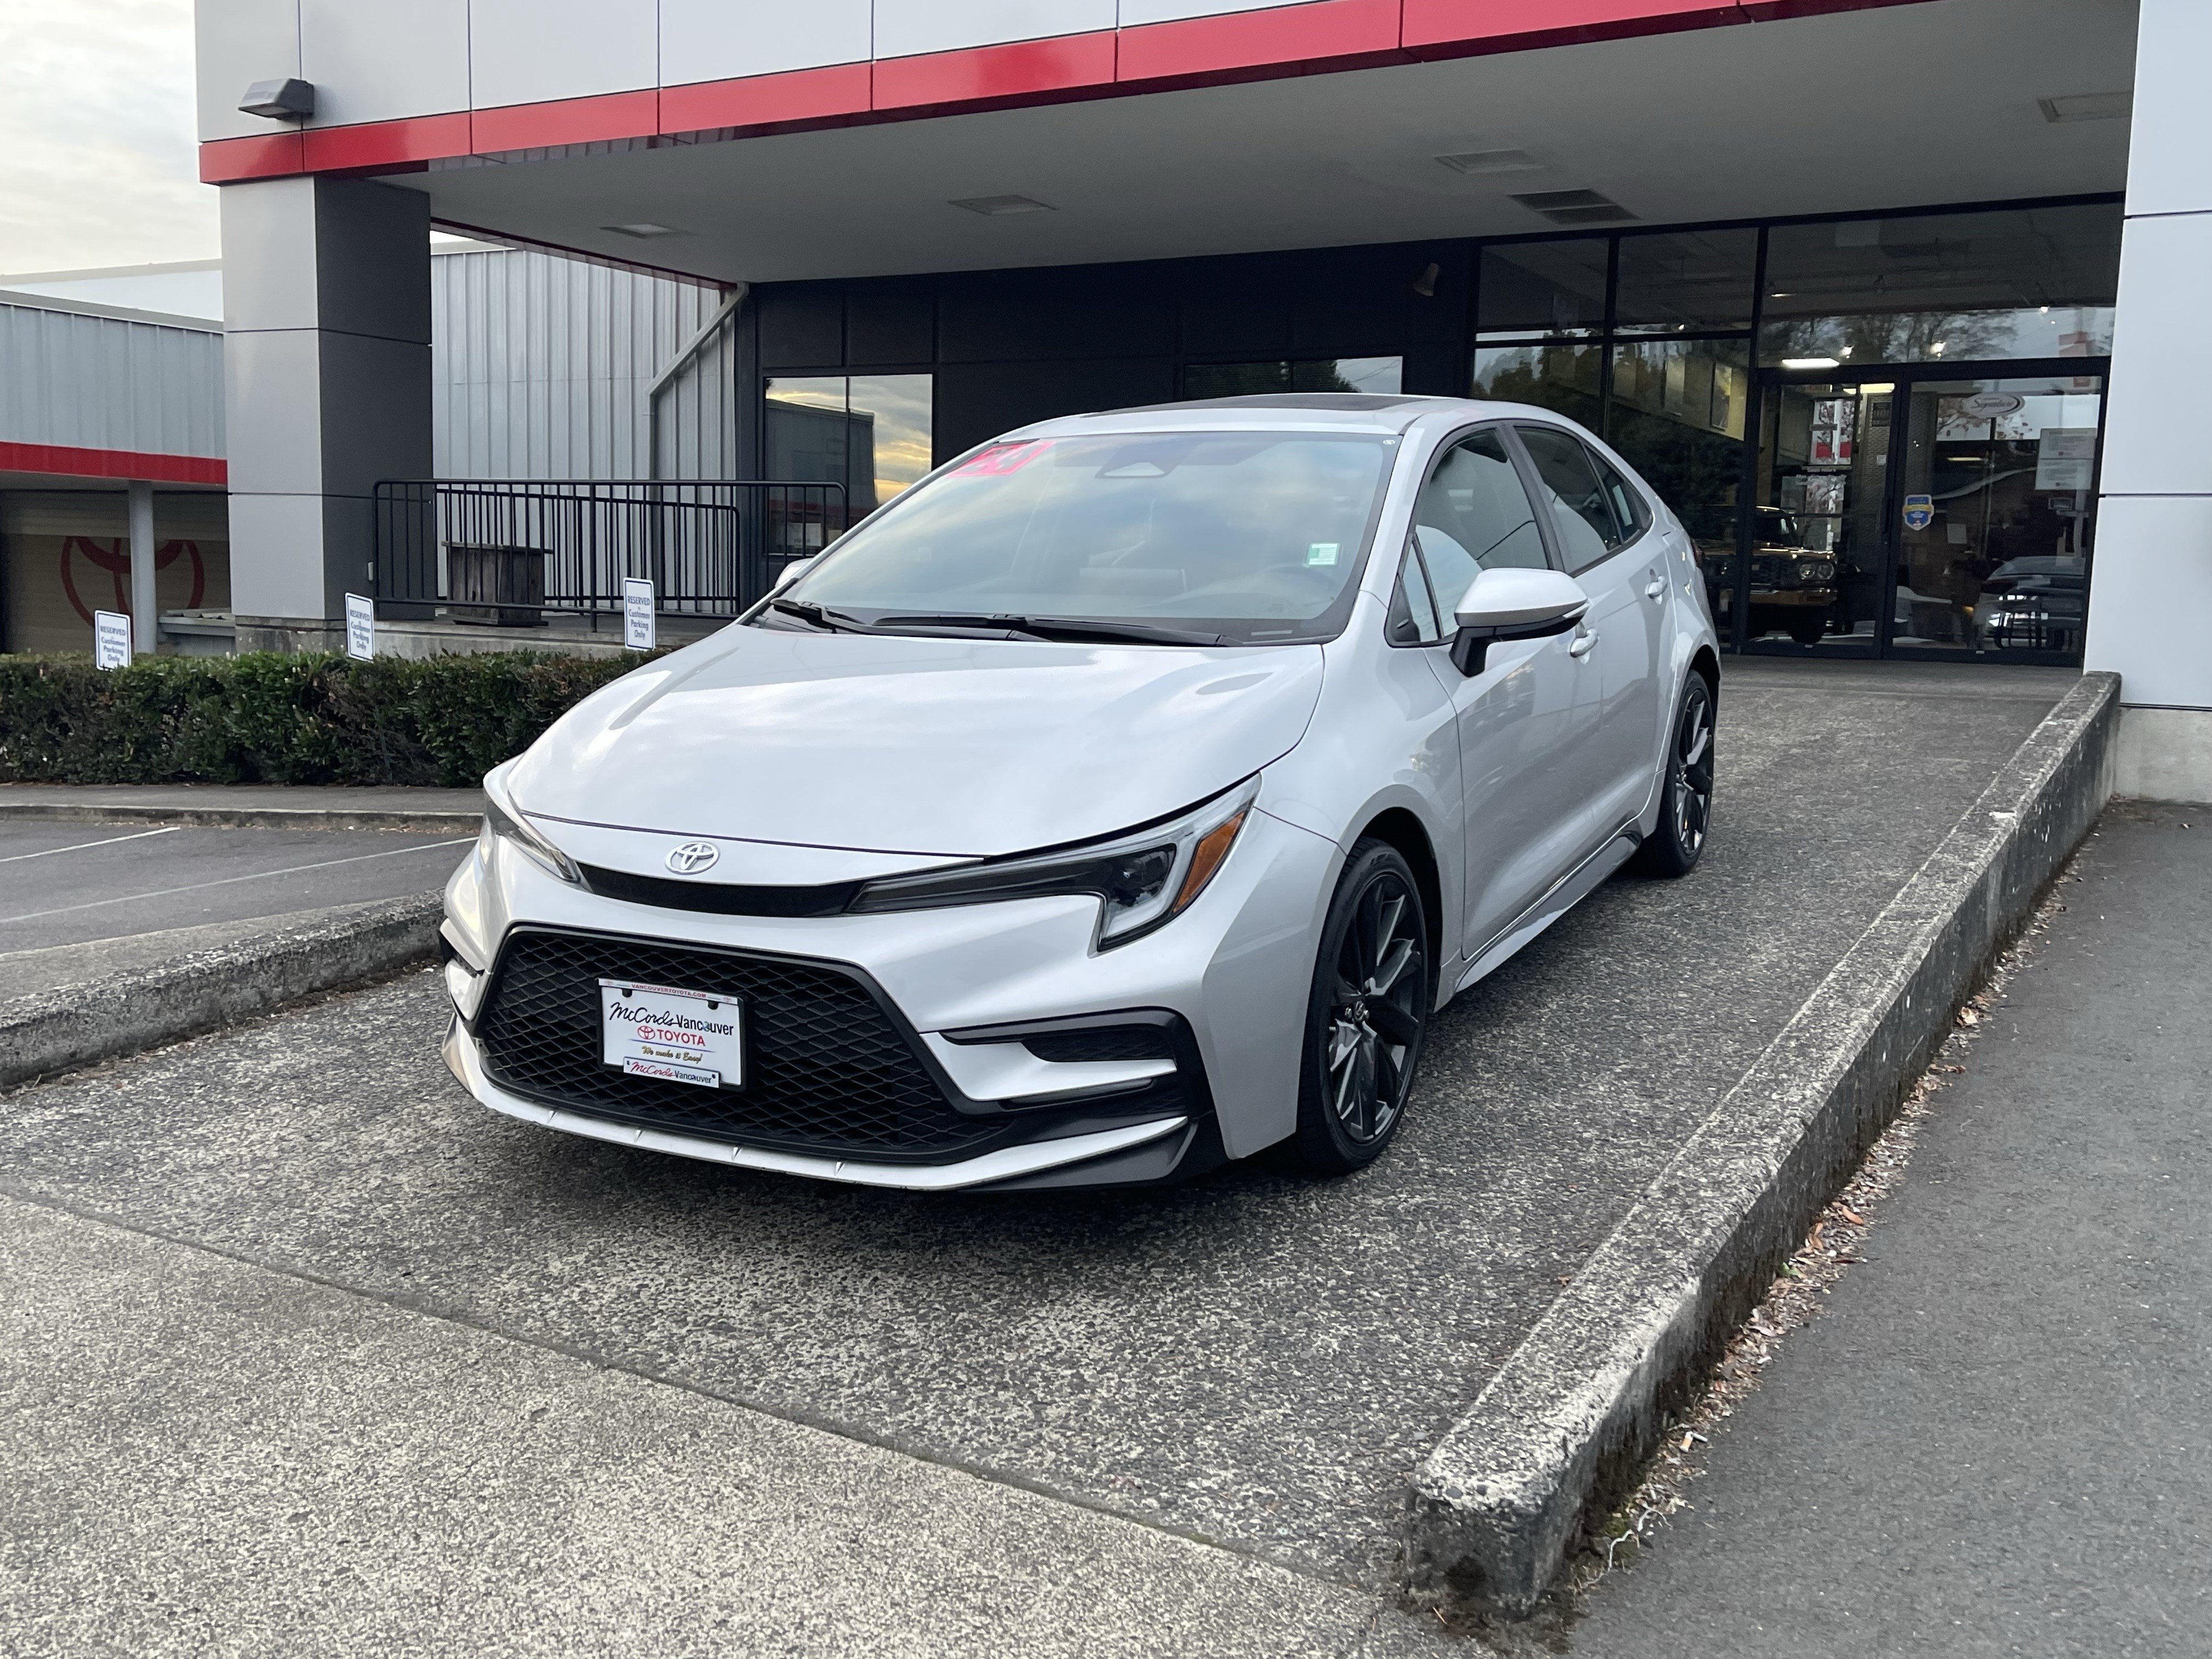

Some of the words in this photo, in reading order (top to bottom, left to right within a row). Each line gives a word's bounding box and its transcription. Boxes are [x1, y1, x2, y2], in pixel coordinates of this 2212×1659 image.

[628, 596, 650, 606] RESERVED
[350, 610, 370, 621] RESERVED
[629, 608, 650, 619] Customer
[631, 619, 648, 631] Parking
[100, 626, 126, 636] RESERVED
[635, 630, 645, 640] Only
[101, 636, 125, 646] Customer
[357, 641, 366, 651] Only
[104, 645, 123, 656] Parking
[108, 654, 120, 663] Only
[631, 984, 706, 998] VANCOUVERTOYOTA.COM
[657, 1029, 706, 1046] TOYOTA
